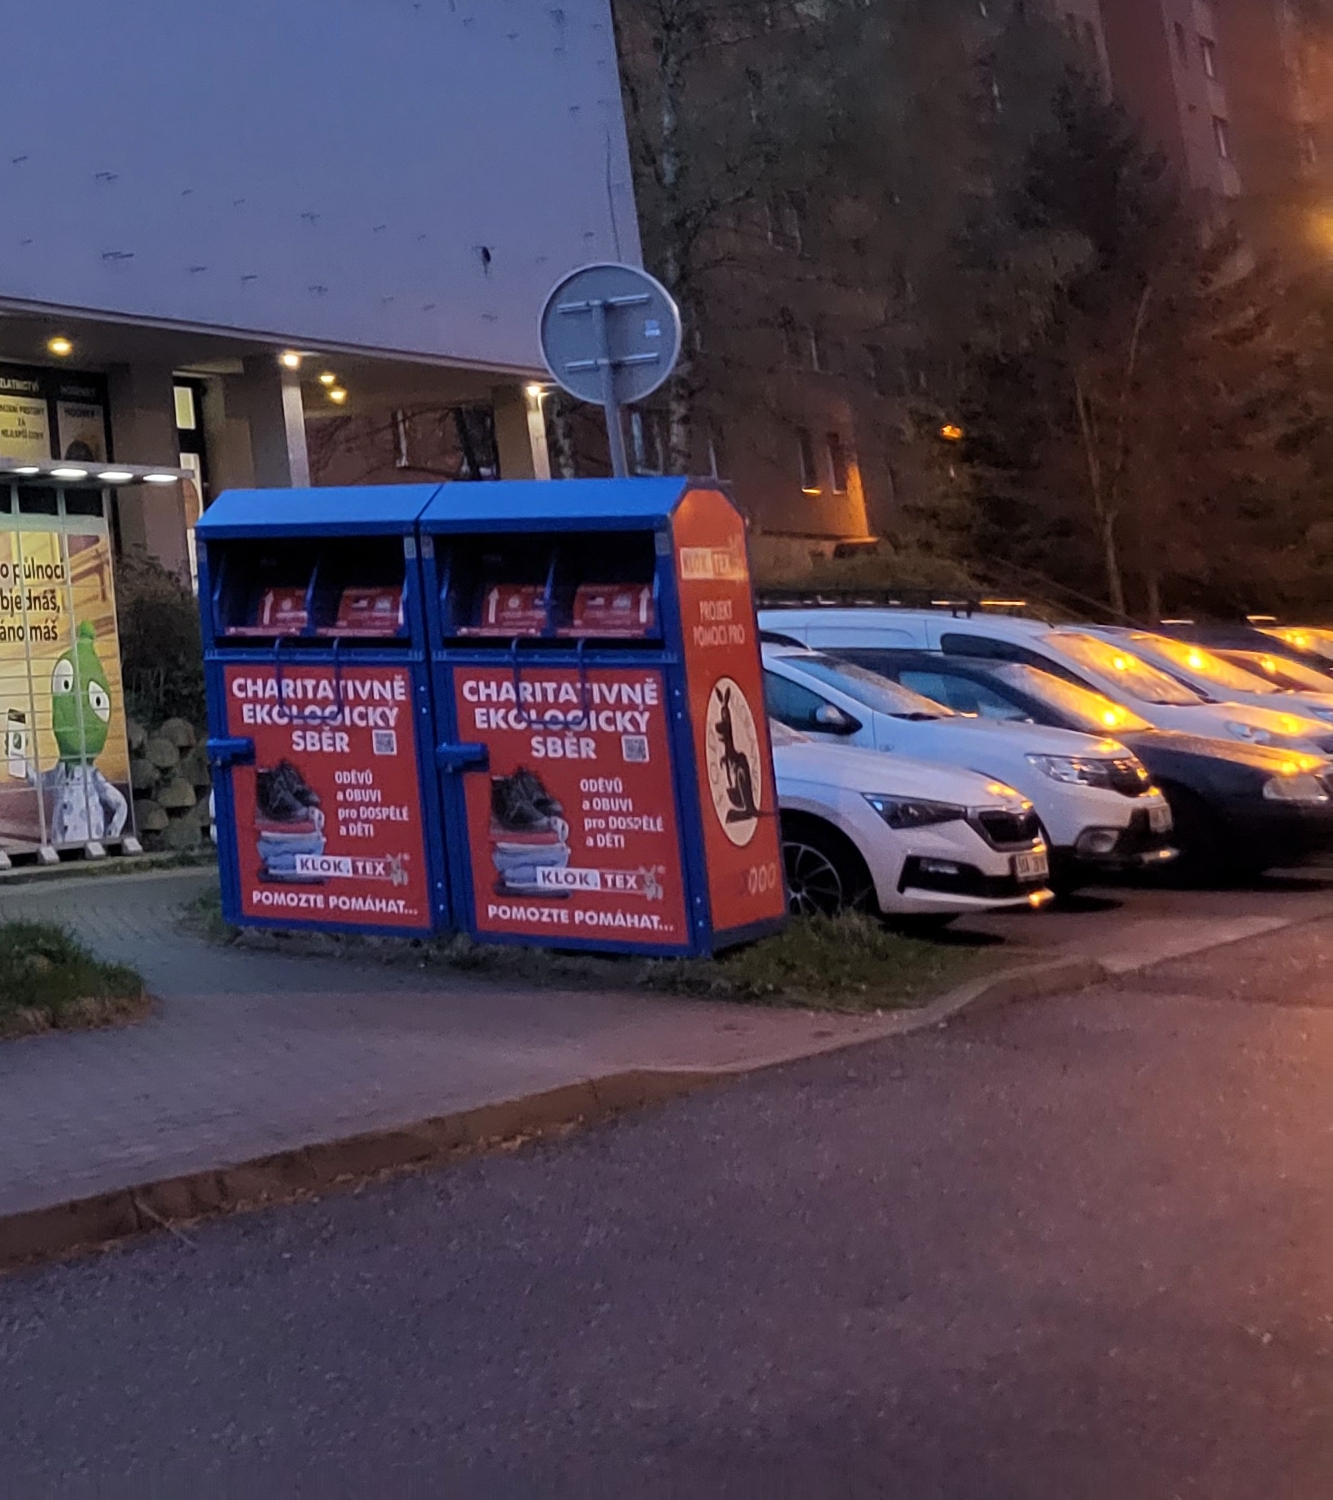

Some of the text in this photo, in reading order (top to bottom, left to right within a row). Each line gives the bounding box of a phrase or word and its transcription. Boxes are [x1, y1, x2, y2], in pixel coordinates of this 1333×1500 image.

[29, 617, 58, 642] máš
[291, 725, 351, 753] SBĚR
[530, 731, 598, 760] SBĚR
[336, 788, 381, 803] a OBUVI
[582, 797, 633, 812] a OBUVI
[338, 808, 357, 821] pro
[339, 821, 374, 837] a DĚTI
[584, 817, 606, 831] pro
[585, 832, 625, 849] a DĚTI
[356, 861, 385, 876] TEX
[604, 874, 638, 890] TEX
[252, 890, 418, 915] POMOZTE POMÁHAT...
[487, 904, 674, 932] POMOZTE POMÁHAT...
